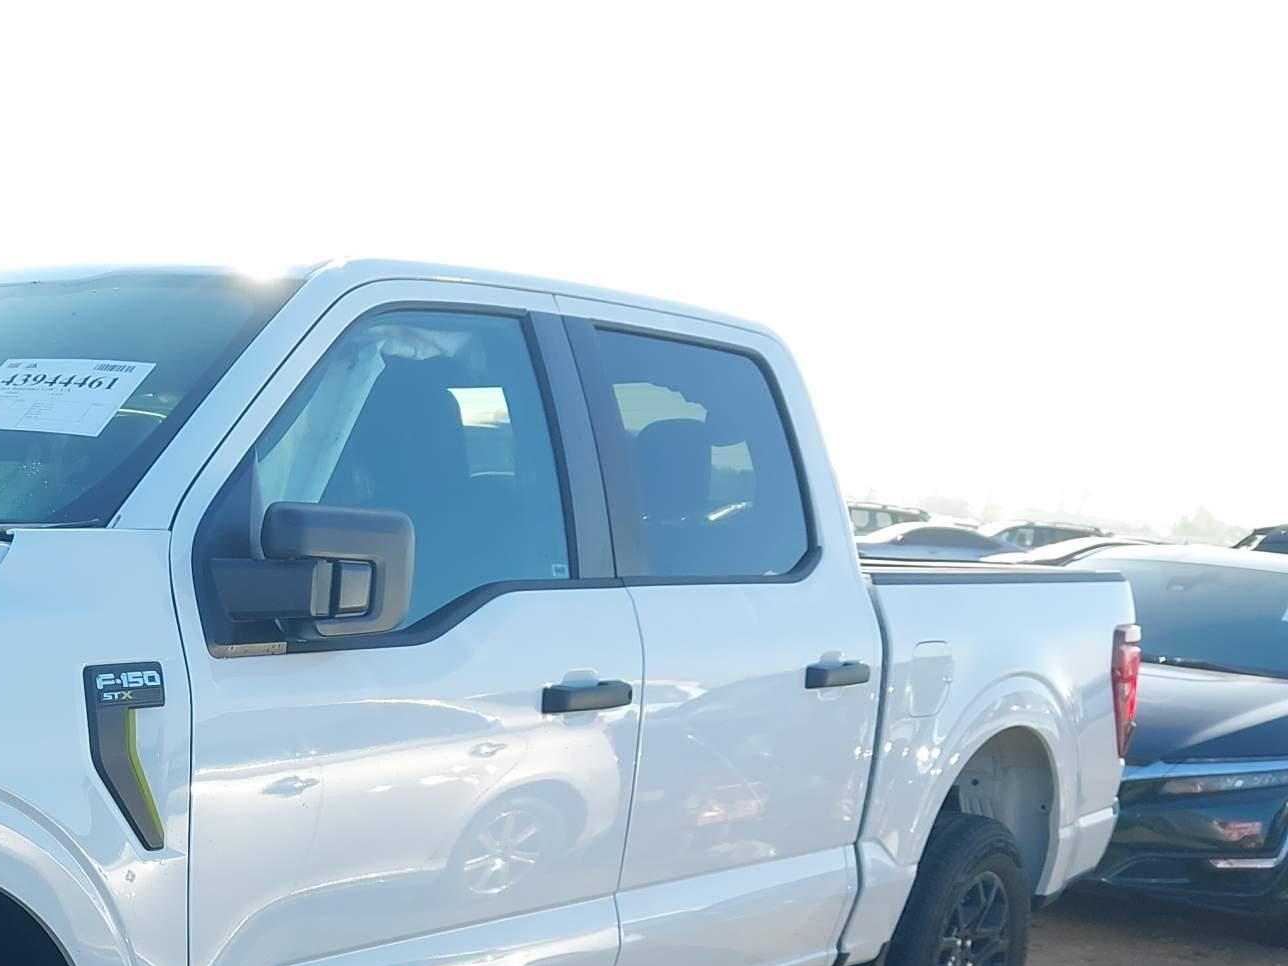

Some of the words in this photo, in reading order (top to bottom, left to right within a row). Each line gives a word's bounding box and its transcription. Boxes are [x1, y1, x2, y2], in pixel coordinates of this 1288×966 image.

[1, 373, 120, 390] 43944461
[96, 671, 161, 689] F-150
[102, 691, 133, 700] STX
